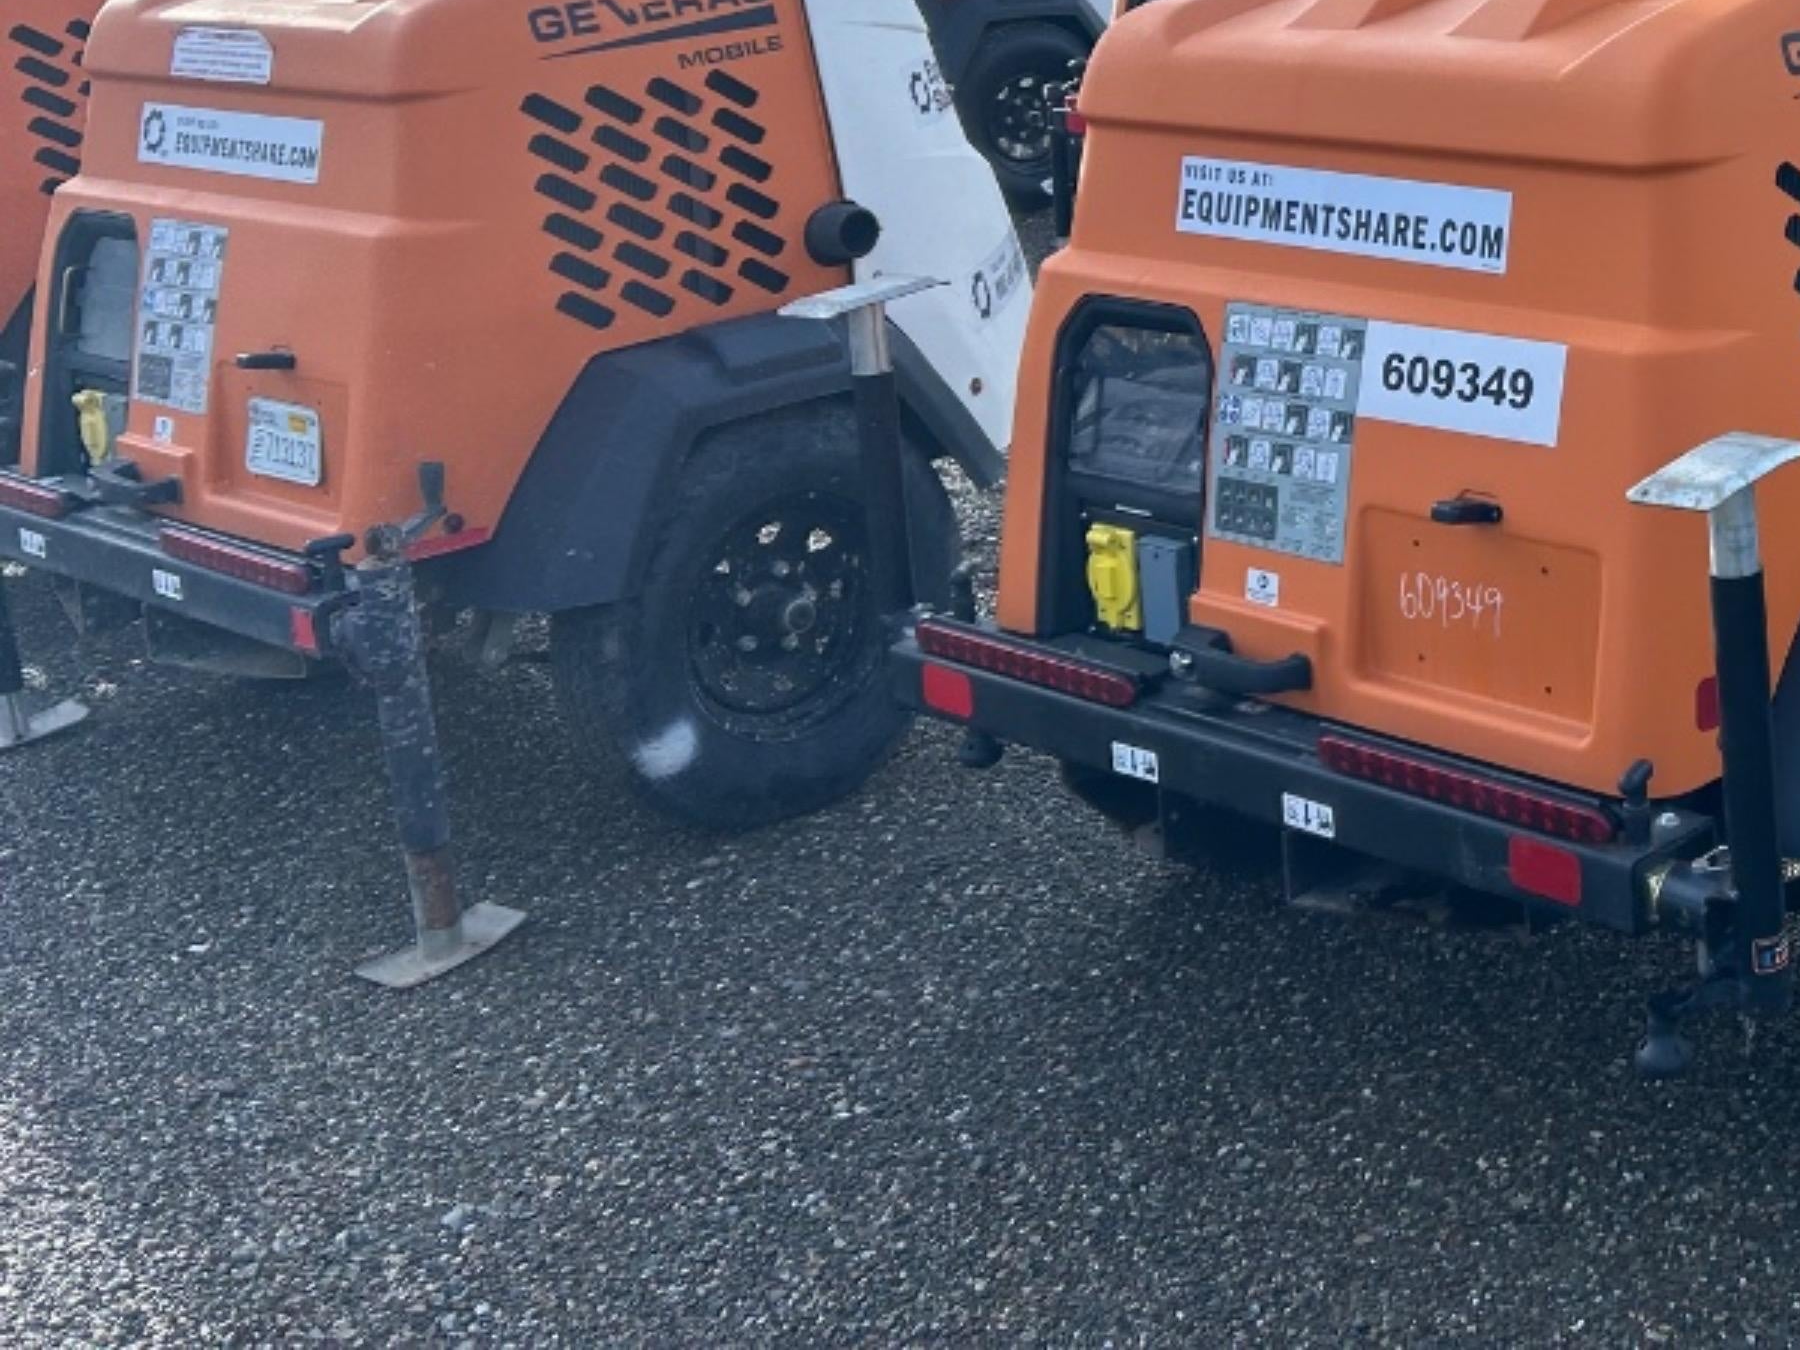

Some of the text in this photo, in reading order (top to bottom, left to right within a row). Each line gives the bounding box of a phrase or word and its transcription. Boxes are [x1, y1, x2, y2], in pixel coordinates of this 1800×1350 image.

[678, 35, 784, 70] MOBILE
[1184, 163, 1222, 182] VISIT
[1228, 169, 1247, 184] US
[1181, 188, 1505, 260] EQUIPMENTSHARE.COM
[1382, 352, 1535, 410] 609349
[1399, 571, 1504, 637] 609349
